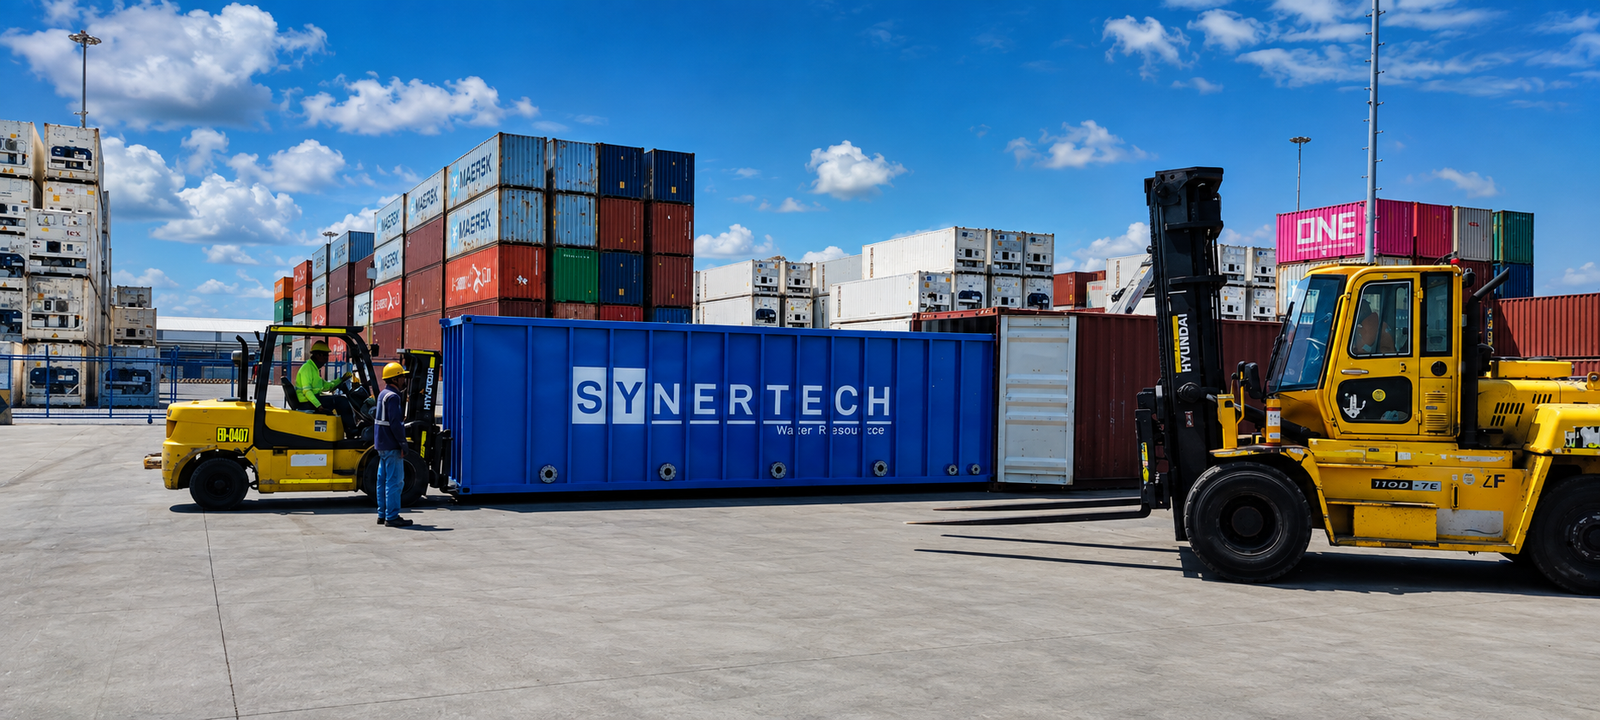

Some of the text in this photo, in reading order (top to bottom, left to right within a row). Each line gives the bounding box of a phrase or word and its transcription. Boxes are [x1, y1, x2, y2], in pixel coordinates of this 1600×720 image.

[459, 153, 492, 189] MAERSK
[459, 208, 491, 239] MAERSK
[1297, 211, 1355, 245] ONE
[1177, 313, 1192, 373] HYUNDAI
[575, 379, 890, 417] SYNERTECH
[1482, 474, 1506, 488] ZF
